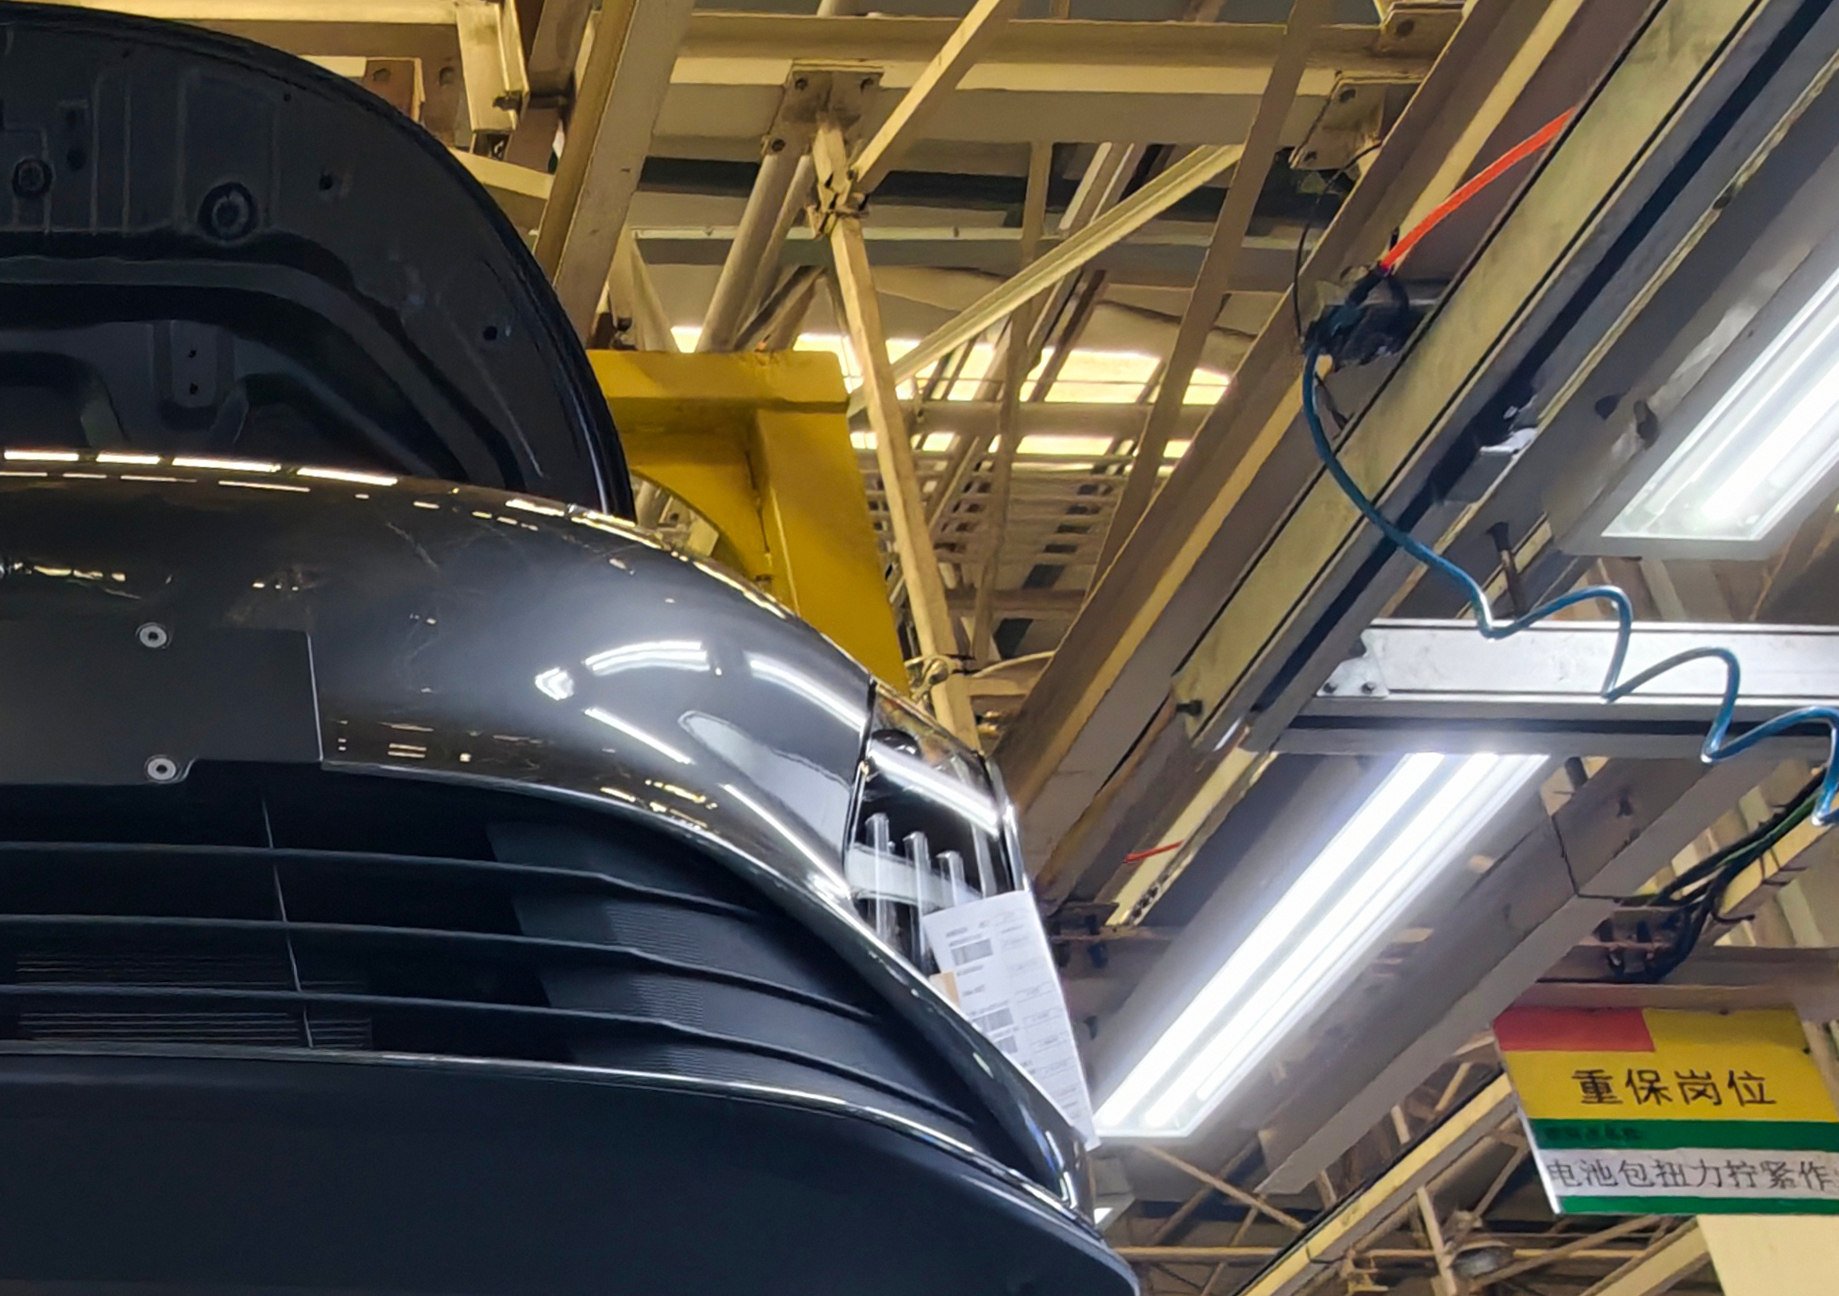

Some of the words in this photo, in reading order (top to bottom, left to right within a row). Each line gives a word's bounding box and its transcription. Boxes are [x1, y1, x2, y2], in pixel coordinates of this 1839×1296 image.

[1571, 1067, 1777, 1107] 重保岗位
[1547, 1158, 1839, 1190] 电池包扭力拧紧作
